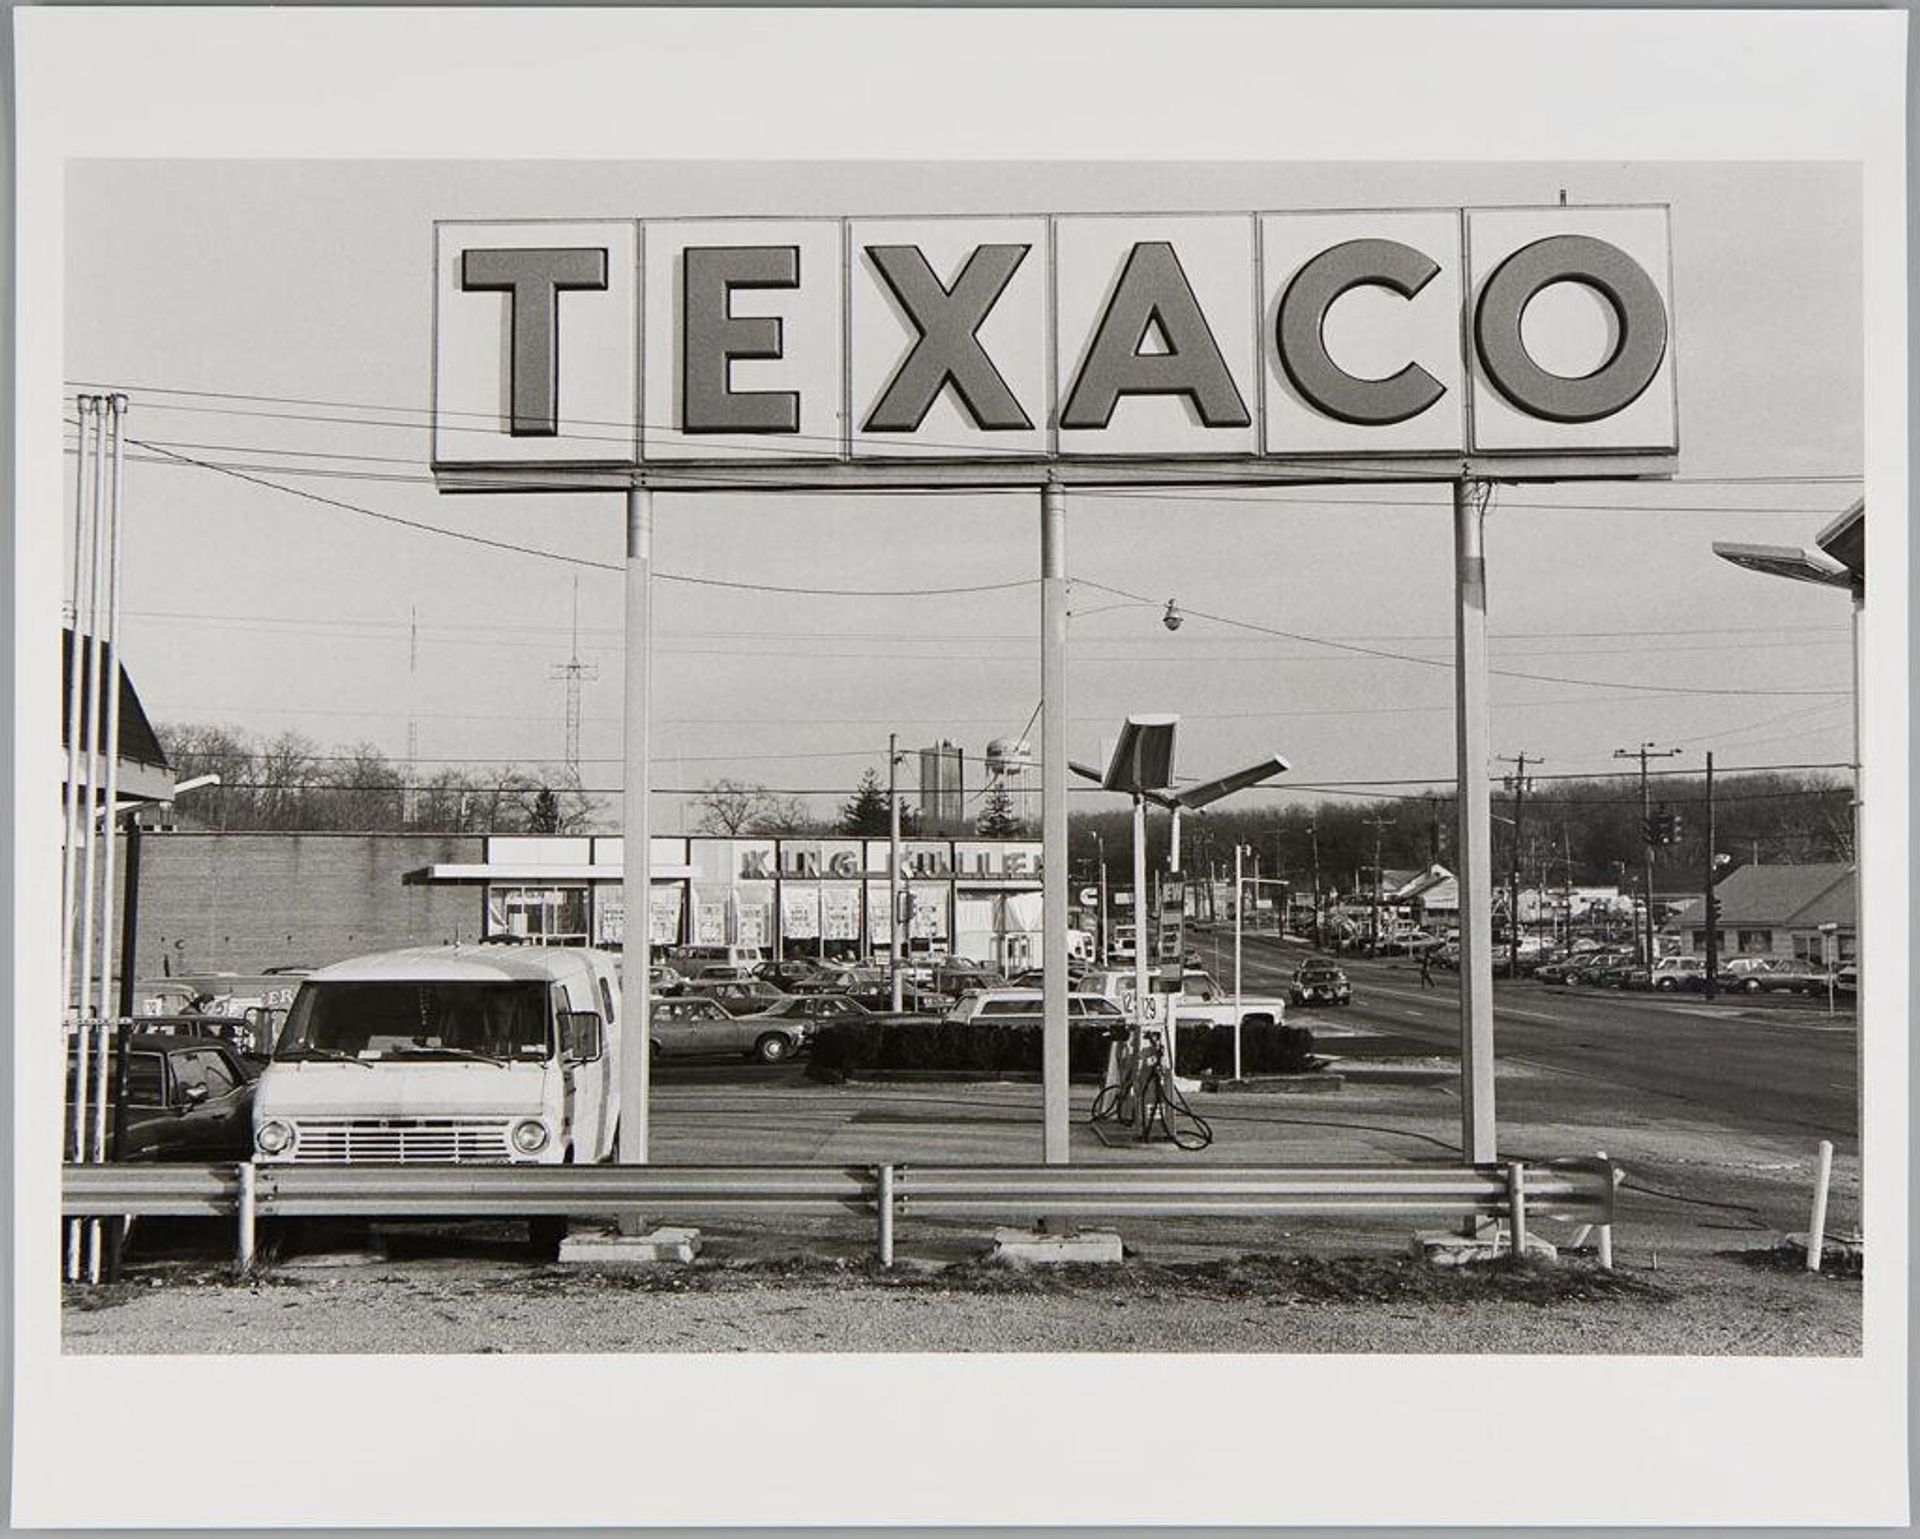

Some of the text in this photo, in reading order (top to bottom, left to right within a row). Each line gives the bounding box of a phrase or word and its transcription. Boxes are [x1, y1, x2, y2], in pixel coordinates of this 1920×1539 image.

[461, 233, 1668, 437] TEXACO
[741, 849, 1044, 879] KING KULLE
